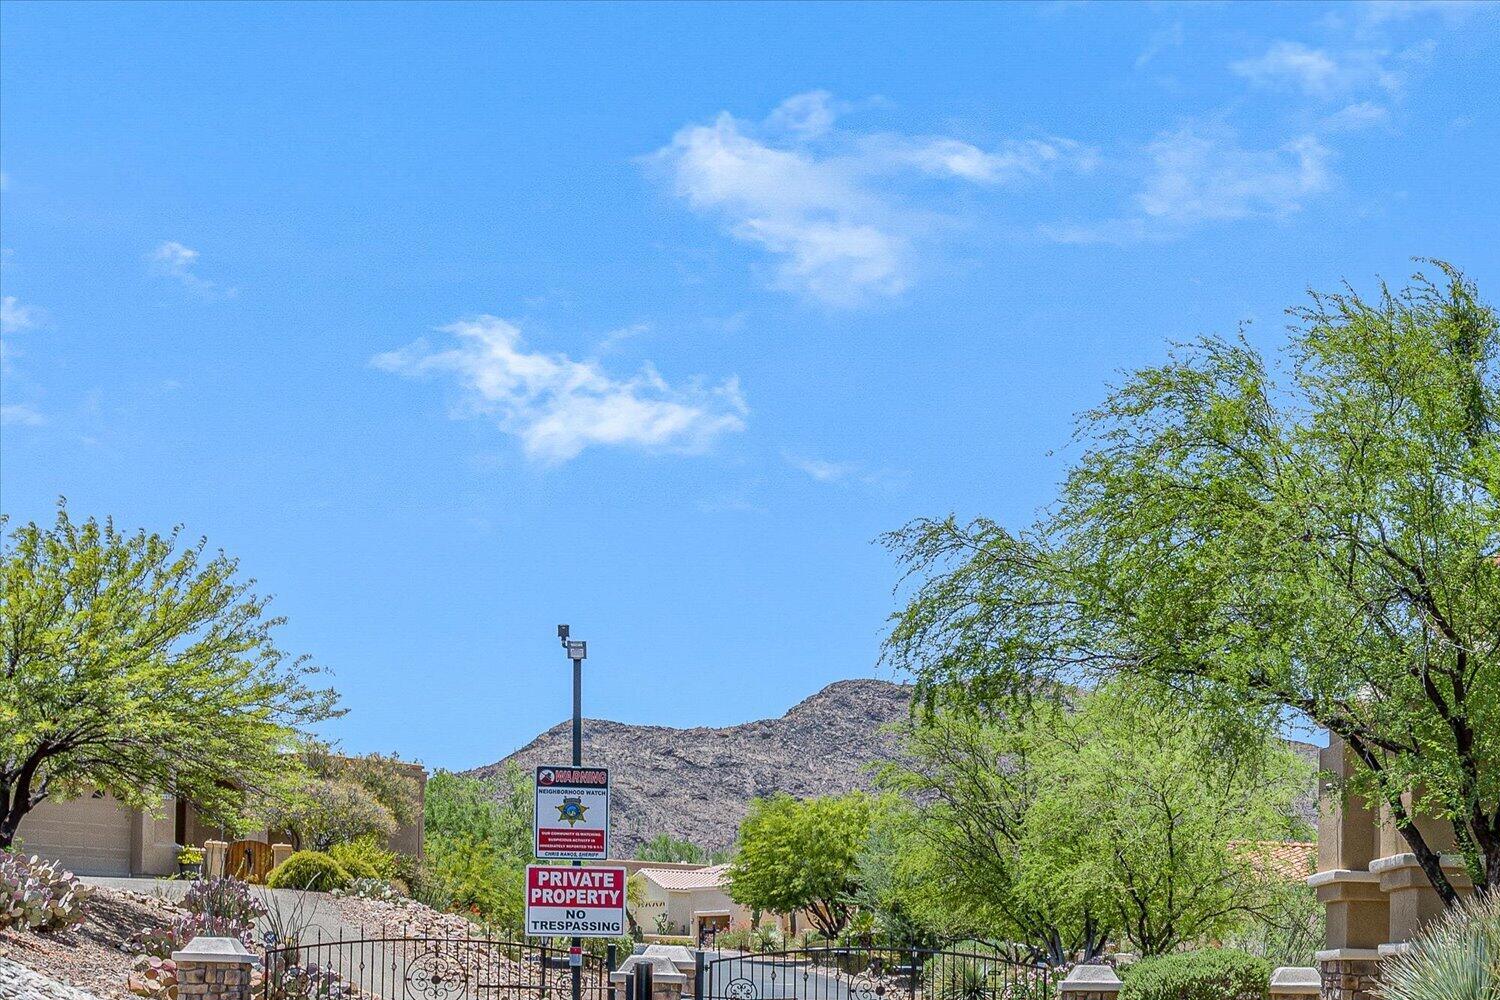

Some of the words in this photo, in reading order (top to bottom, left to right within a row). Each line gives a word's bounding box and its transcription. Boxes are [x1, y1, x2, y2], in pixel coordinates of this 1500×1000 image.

[555, 770, 607, 784] WARNING
[538, 871, 614, 888] PRIVATE
[531, 888, 620, 905] PROPERTY
[566, 910, 586, 919] NO
[532, 920, 620, 931] TRESPASSING
